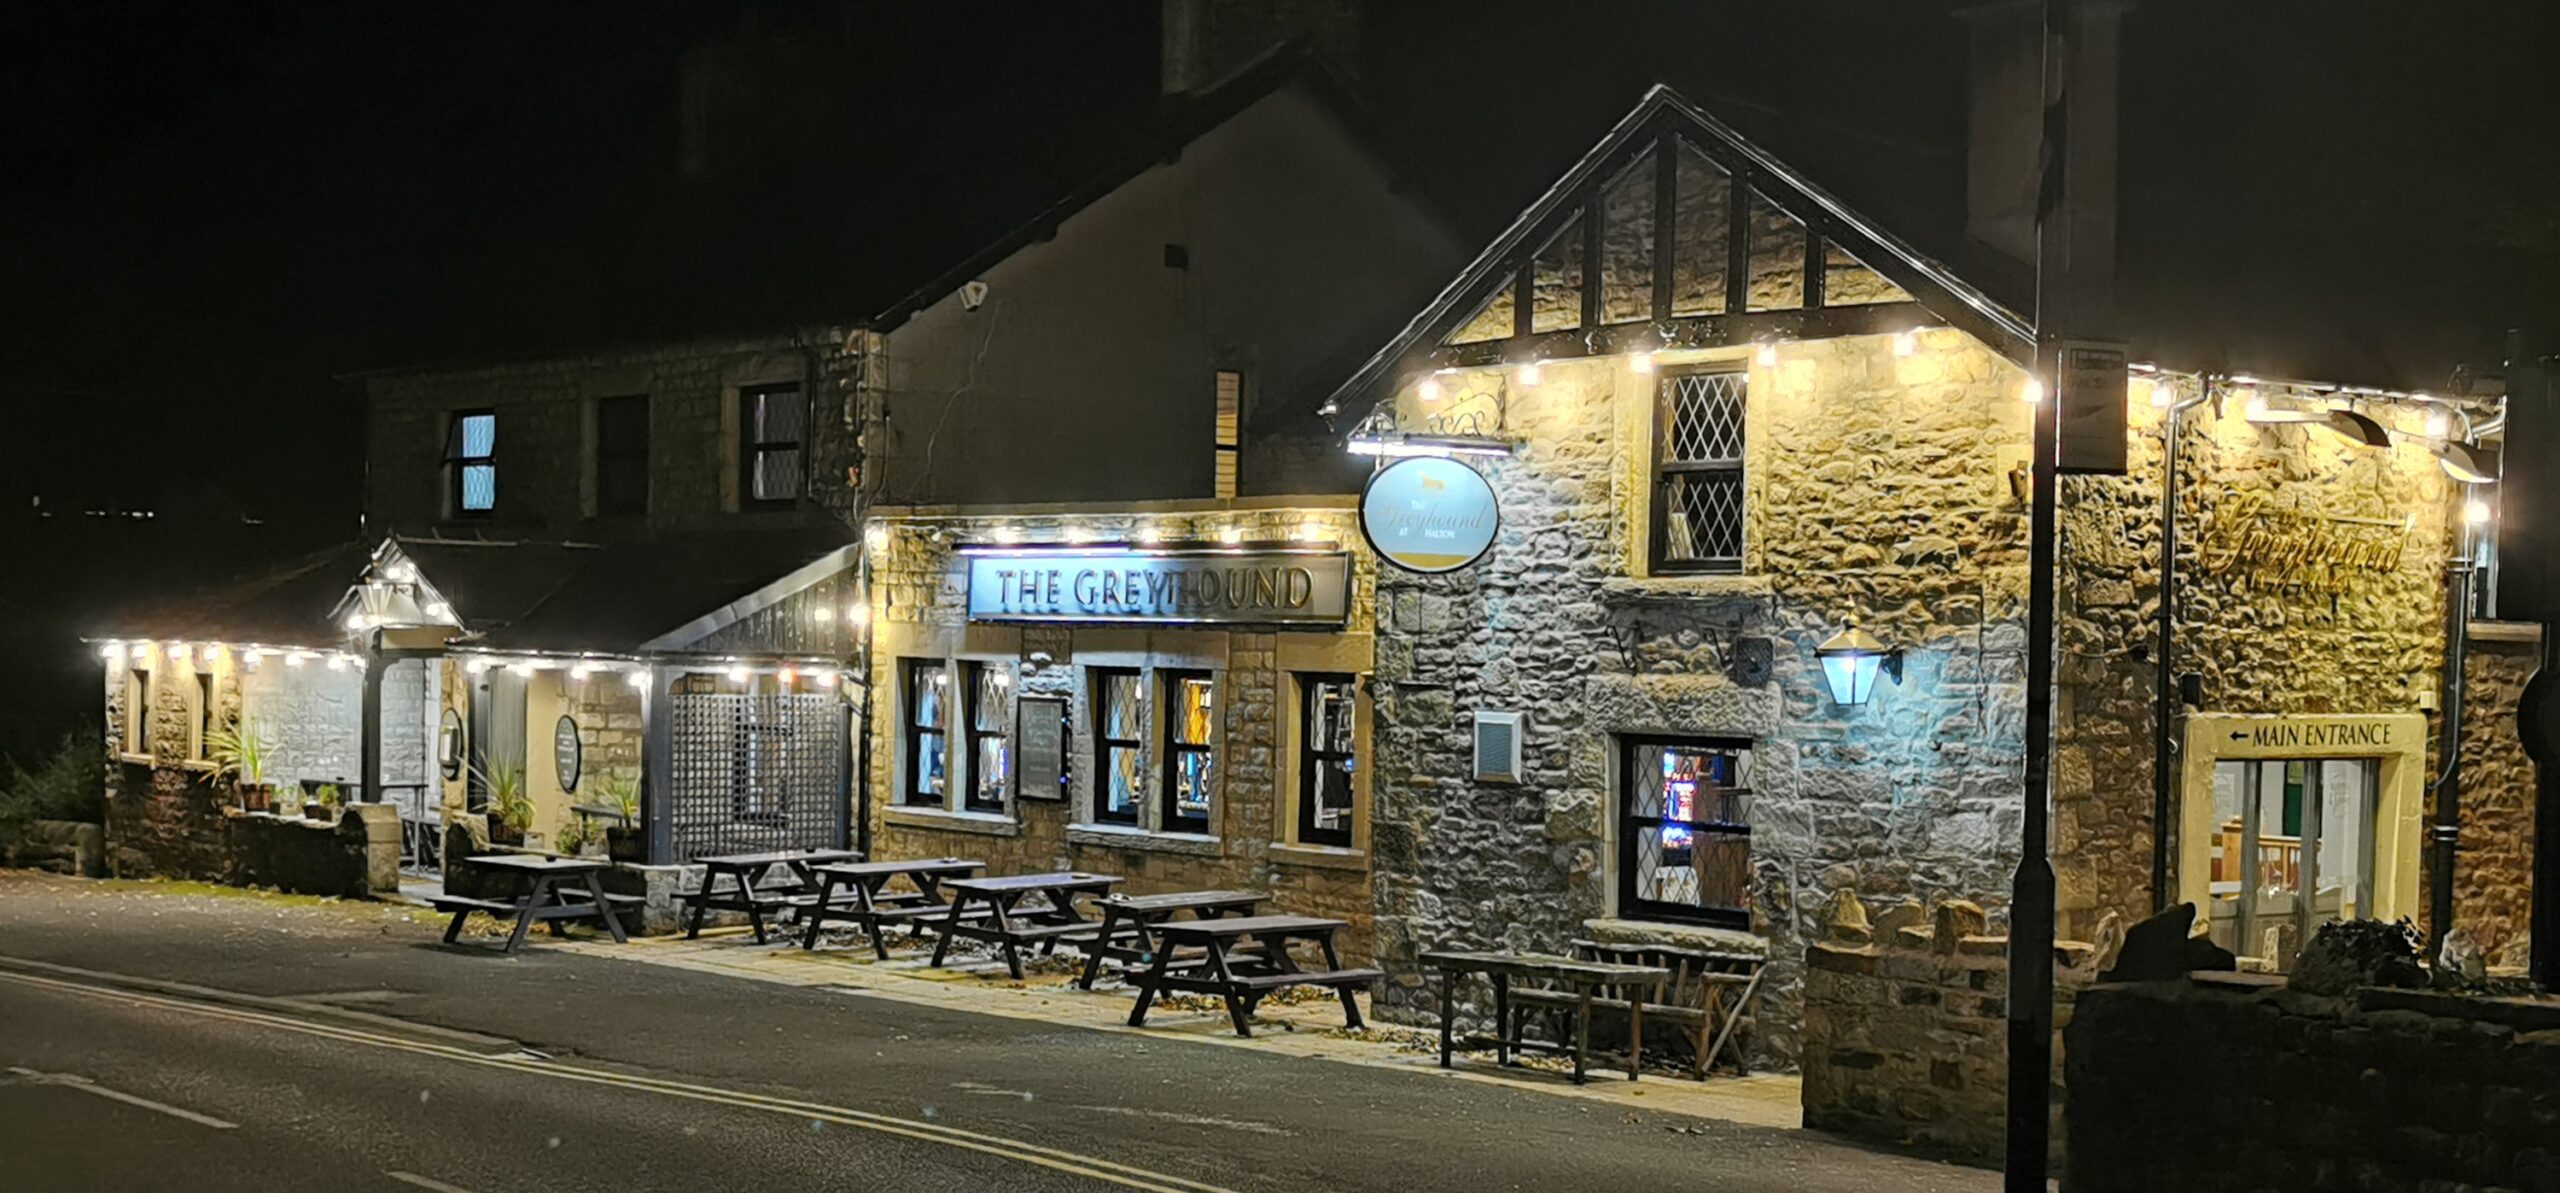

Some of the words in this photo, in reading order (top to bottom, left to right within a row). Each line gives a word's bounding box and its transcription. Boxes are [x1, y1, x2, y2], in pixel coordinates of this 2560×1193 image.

[1382, 502, 1488, 531] Greyhound
[998, 570, 1061, 605] THE
[1074, 566, 1313, 609] GREYHOUND
[2253, 725, 2300, 746] MAIN
[2304, 723, 2392, 746] ENTRANCE
